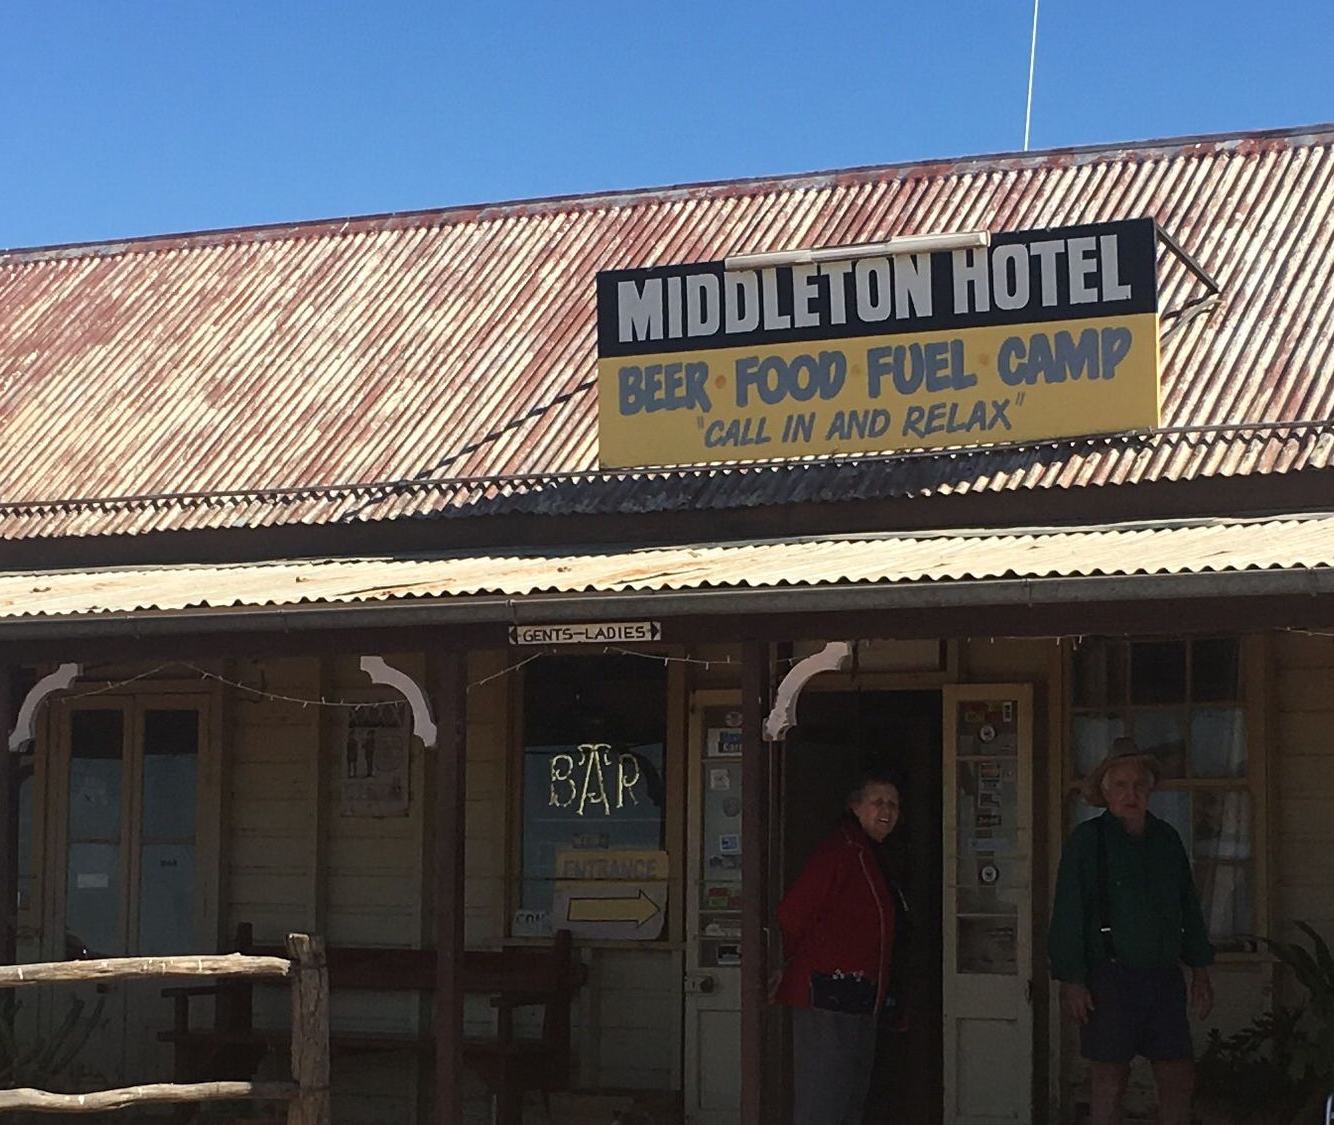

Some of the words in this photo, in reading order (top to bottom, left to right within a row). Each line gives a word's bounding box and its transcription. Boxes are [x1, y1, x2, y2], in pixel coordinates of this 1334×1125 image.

[617, 253, 933, 343] MIDDLETON
[952, 234, 1132, 315] HOTEL
[618, 361, 709, 416] BEER
[736, 350, 847, 407] FOOD
[867, 339, 977, 399] FUEL
[997, 327, 1133, 386] CAMP
[781, 412, 816, 443] IN
[825, 408, 891, 440] AND
[549, 743, 641, 815] BAR
[561, 858, 658, 879] ENTRANCE
